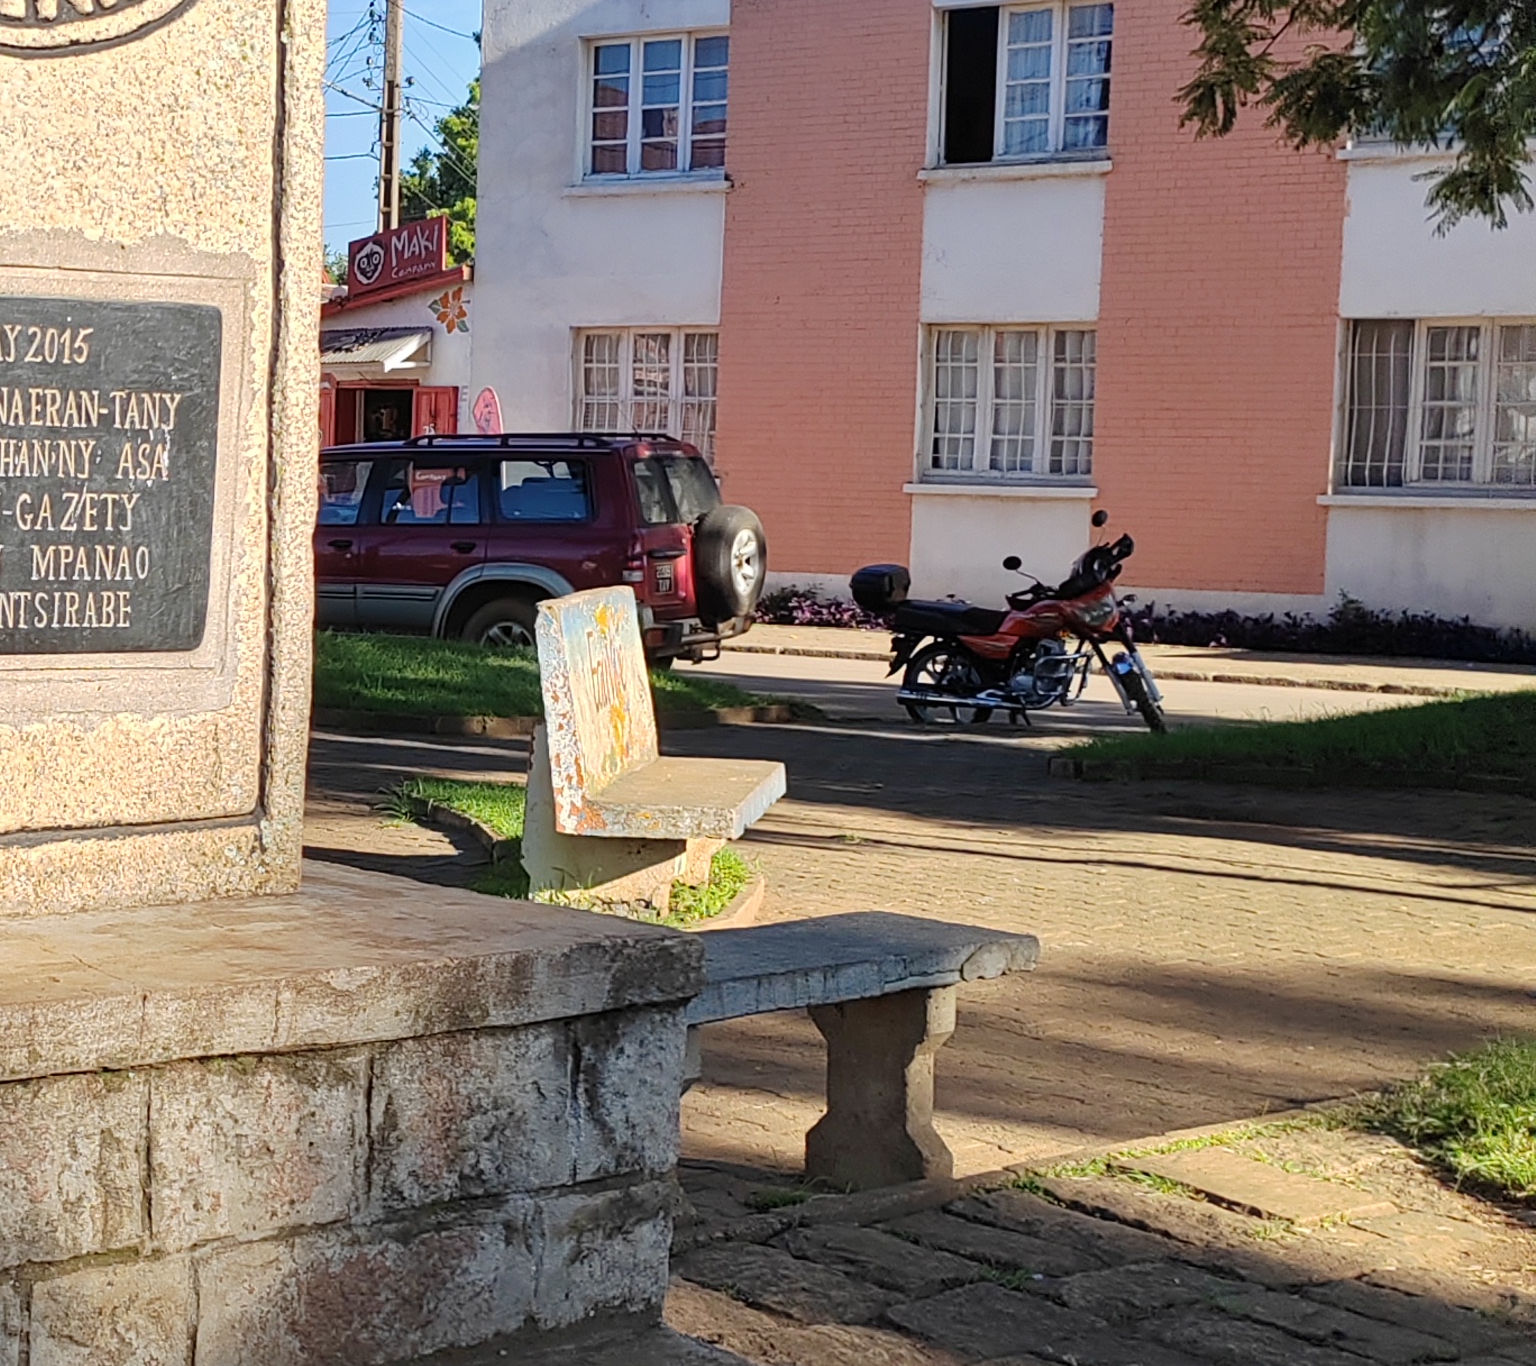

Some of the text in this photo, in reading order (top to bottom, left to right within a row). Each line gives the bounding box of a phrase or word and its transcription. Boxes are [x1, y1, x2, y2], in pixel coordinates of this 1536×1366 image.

[391, 223, 440, 268] MAKI
[24, 326, 94, 364] 2015
[115, 441, 170, 481] ASA
[30, 544, 150, 581] MPANAO
